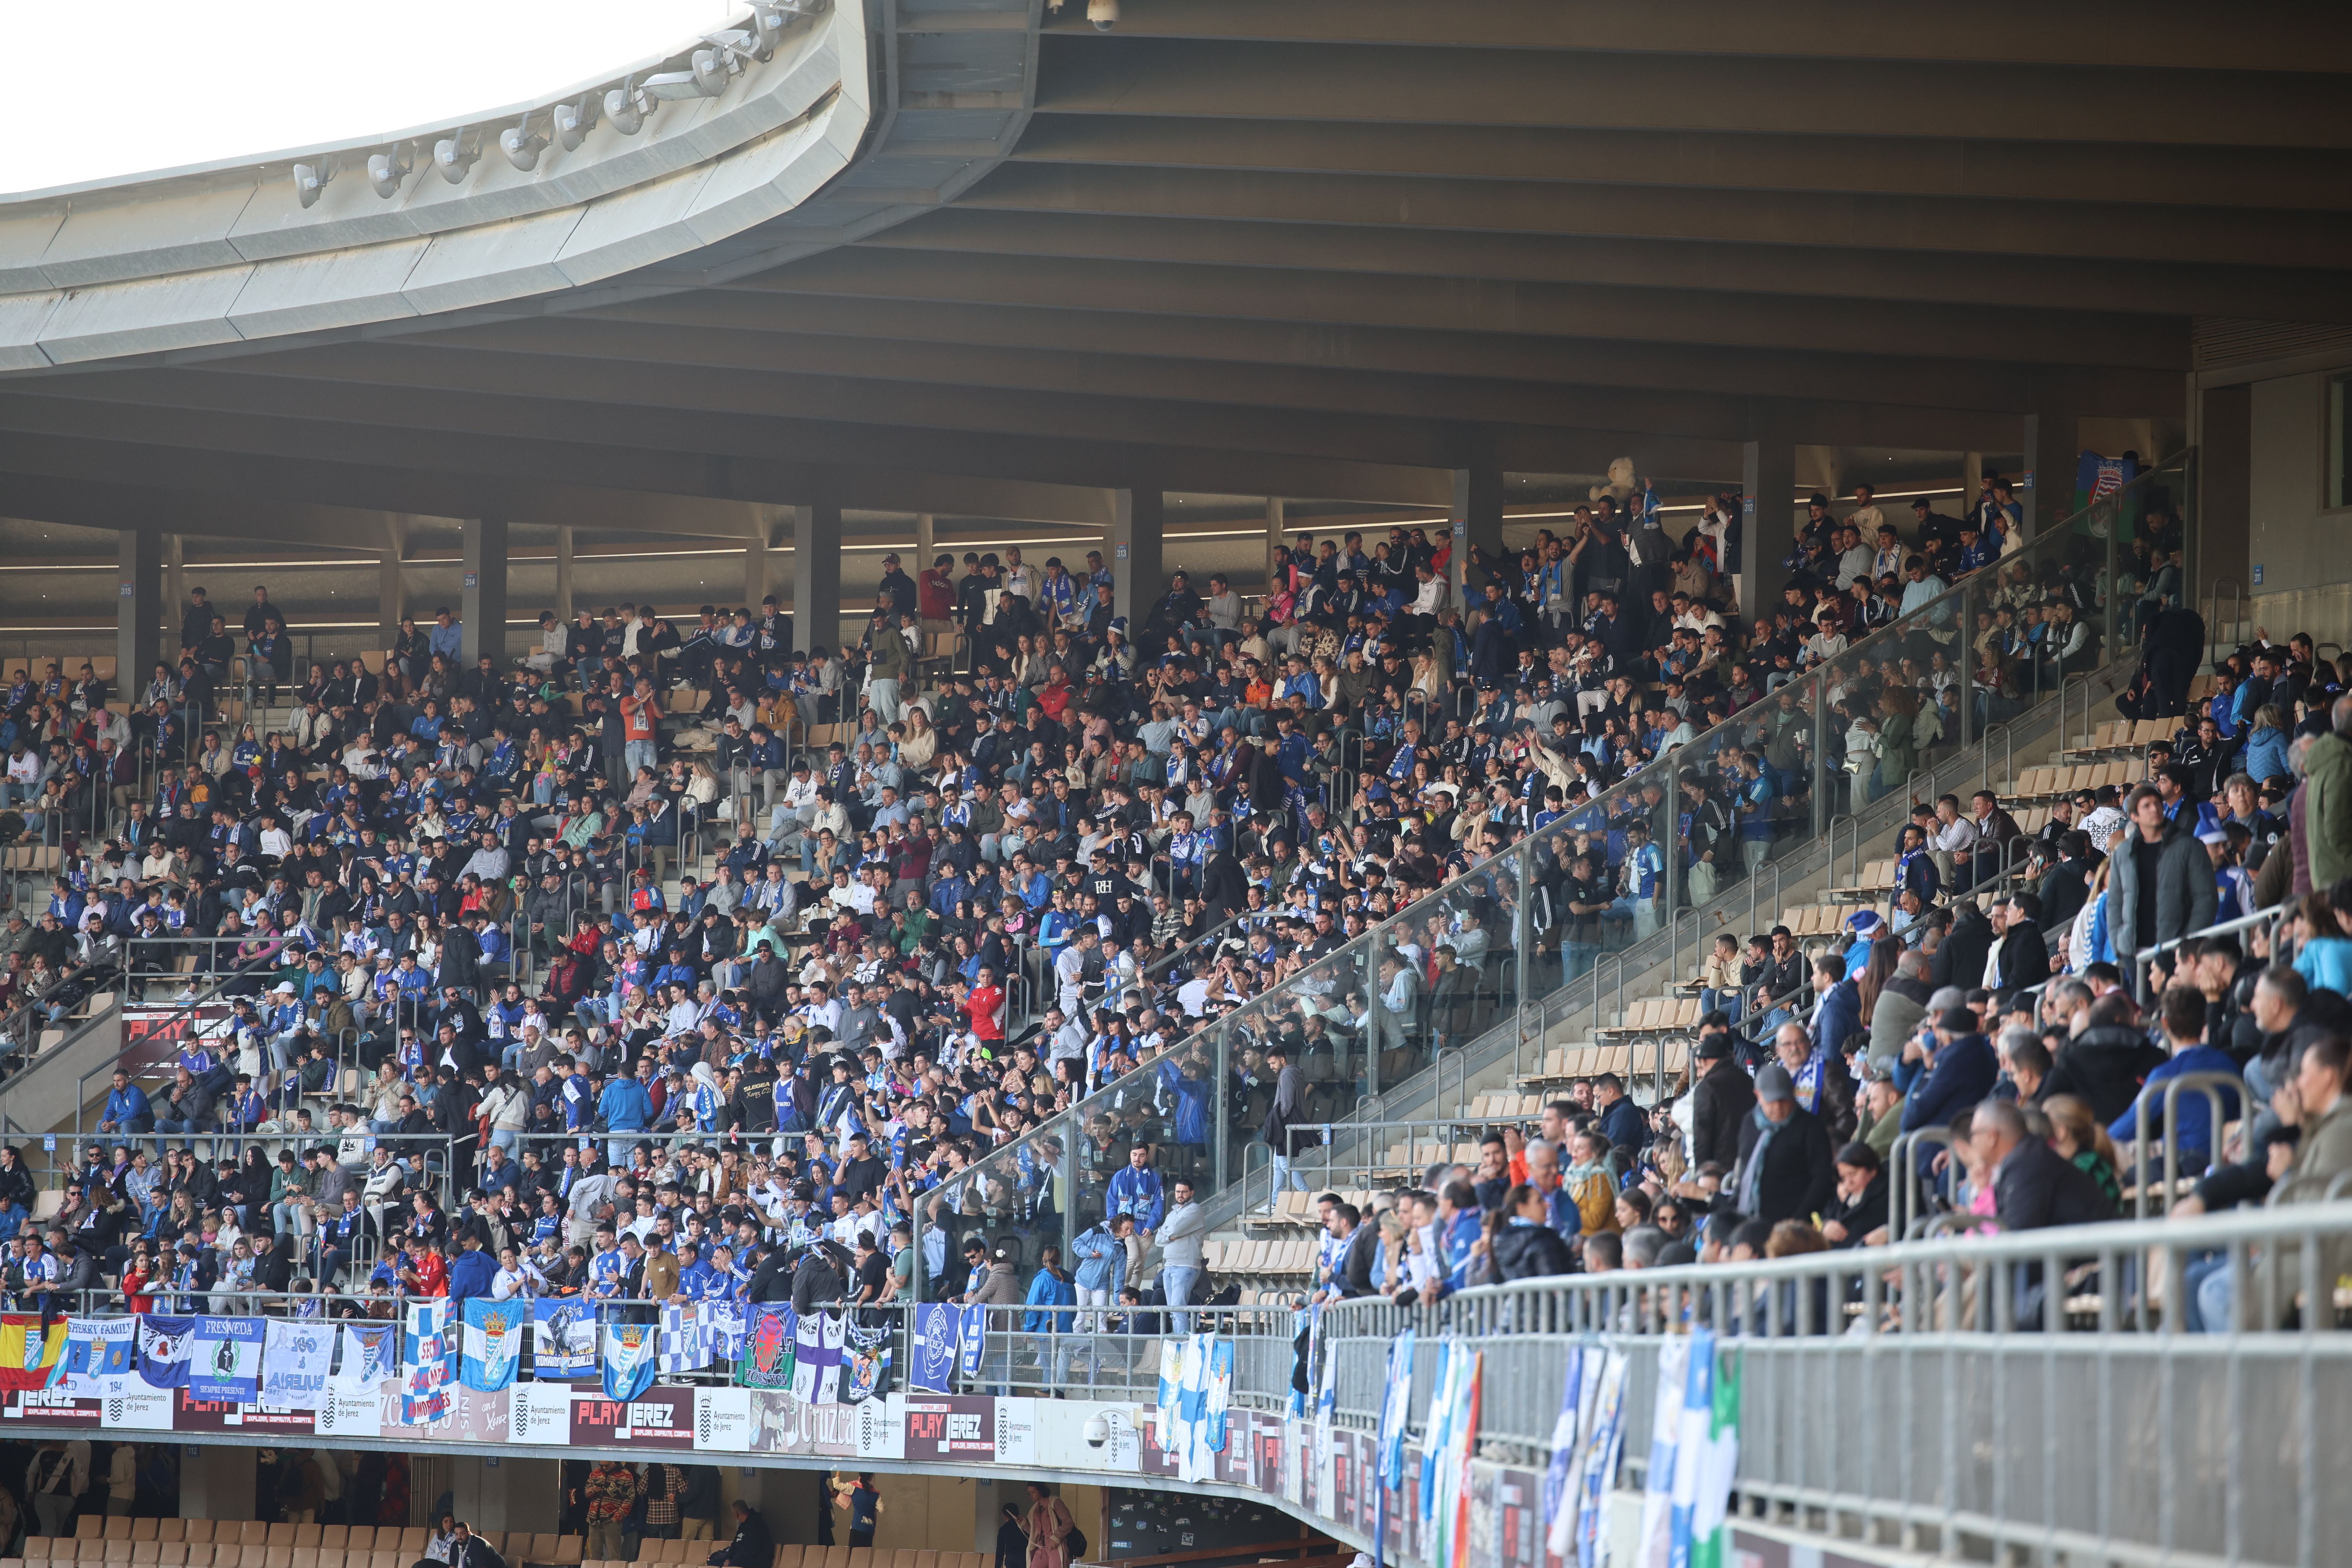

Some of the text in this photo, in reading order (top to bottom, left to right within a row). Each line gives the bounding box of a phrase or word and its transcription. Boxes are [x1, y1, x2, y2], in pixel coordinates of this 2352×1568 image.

[1744, 503, 1753, 512] 312
[131, 1020, 188, 1040] PLAY
[67, 1322, 132, 1334] SHERRY FAMILY
[205, 1320, 252, 1335] FRESNEDA
[568, 1354, 595, 1368] CABALLO
[109, 1381, 124, 1392] 194
[200, 1385, 245, 1395] SIEMPRE PRESENTE
[127, 1393, 166, 1402] Ayuntamiento
[134, 1403, 149, 1412] Jerez
[338, 1398, 375, 1408] Ayuntamiento
[27, 1408, 50, 1417] EXPLORA,
[338, 1408, 359, 1417] de Jerez
[461, 1396, 470, 1429] SIN
[530, 1405, 565, 1415] Ayuntamiento
[714, 1410, 745, 1420] Ayuntamiento
[486, 1413, 507, 1432] Xerez
[530, 1416, 550, 1426] de Jerez
[578, 1402, 674, 1439] PLAY JEREZ
[874, 1418, 901, 1427] Ayuntamiento
[714, 1421, 731, 1431] de Jerez
[1009, 1421, 1031, 1431] Ayuntamiento
[654, 1430, 673, 1438] DISFRUTA,
[874, 1429, 889, 1439] de Jerez
[911, 1414, 981, 1452] PLAY JEREZ
[1009, 1432, 1022, 1443] de Jerez
[1119, 1428, 1137, 1438] Ayuntamiento
[1119, 1440, 1122, 1449] de
